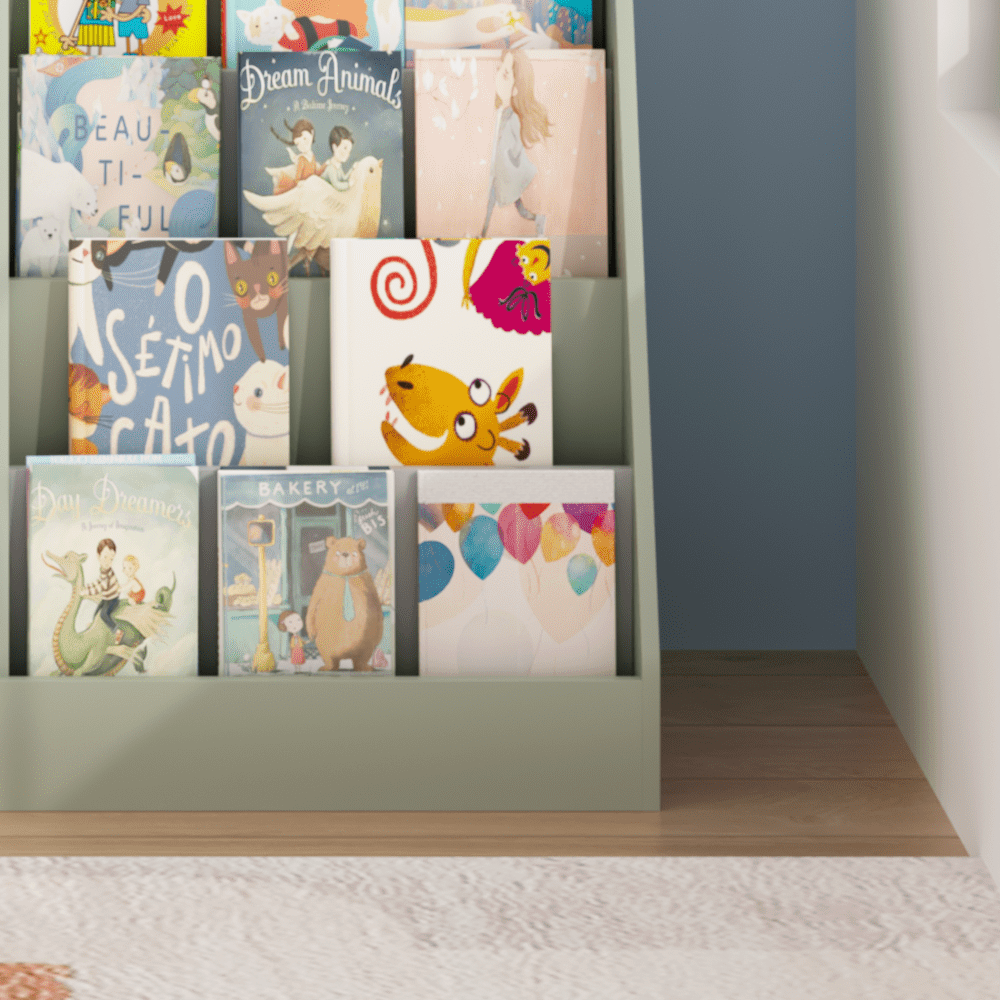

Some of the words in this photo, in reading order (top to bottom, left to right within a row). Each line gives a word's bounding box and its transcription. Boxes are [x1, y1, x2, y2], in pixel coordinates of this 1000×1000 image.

[240, 58, 313, 111] Dream
[317, 50, 402, 109] Animals
[74, 114, 170, 141] BEAU-
[98, 159, 142, 186] TI-
[118, 204, 169, 231] FUL
[174, 261, 211, 334] O
[31, 480, 80, 526] Day
[90, 473, 192, 528] Dreamers
[258, 480, 341, 496] BAKERY
